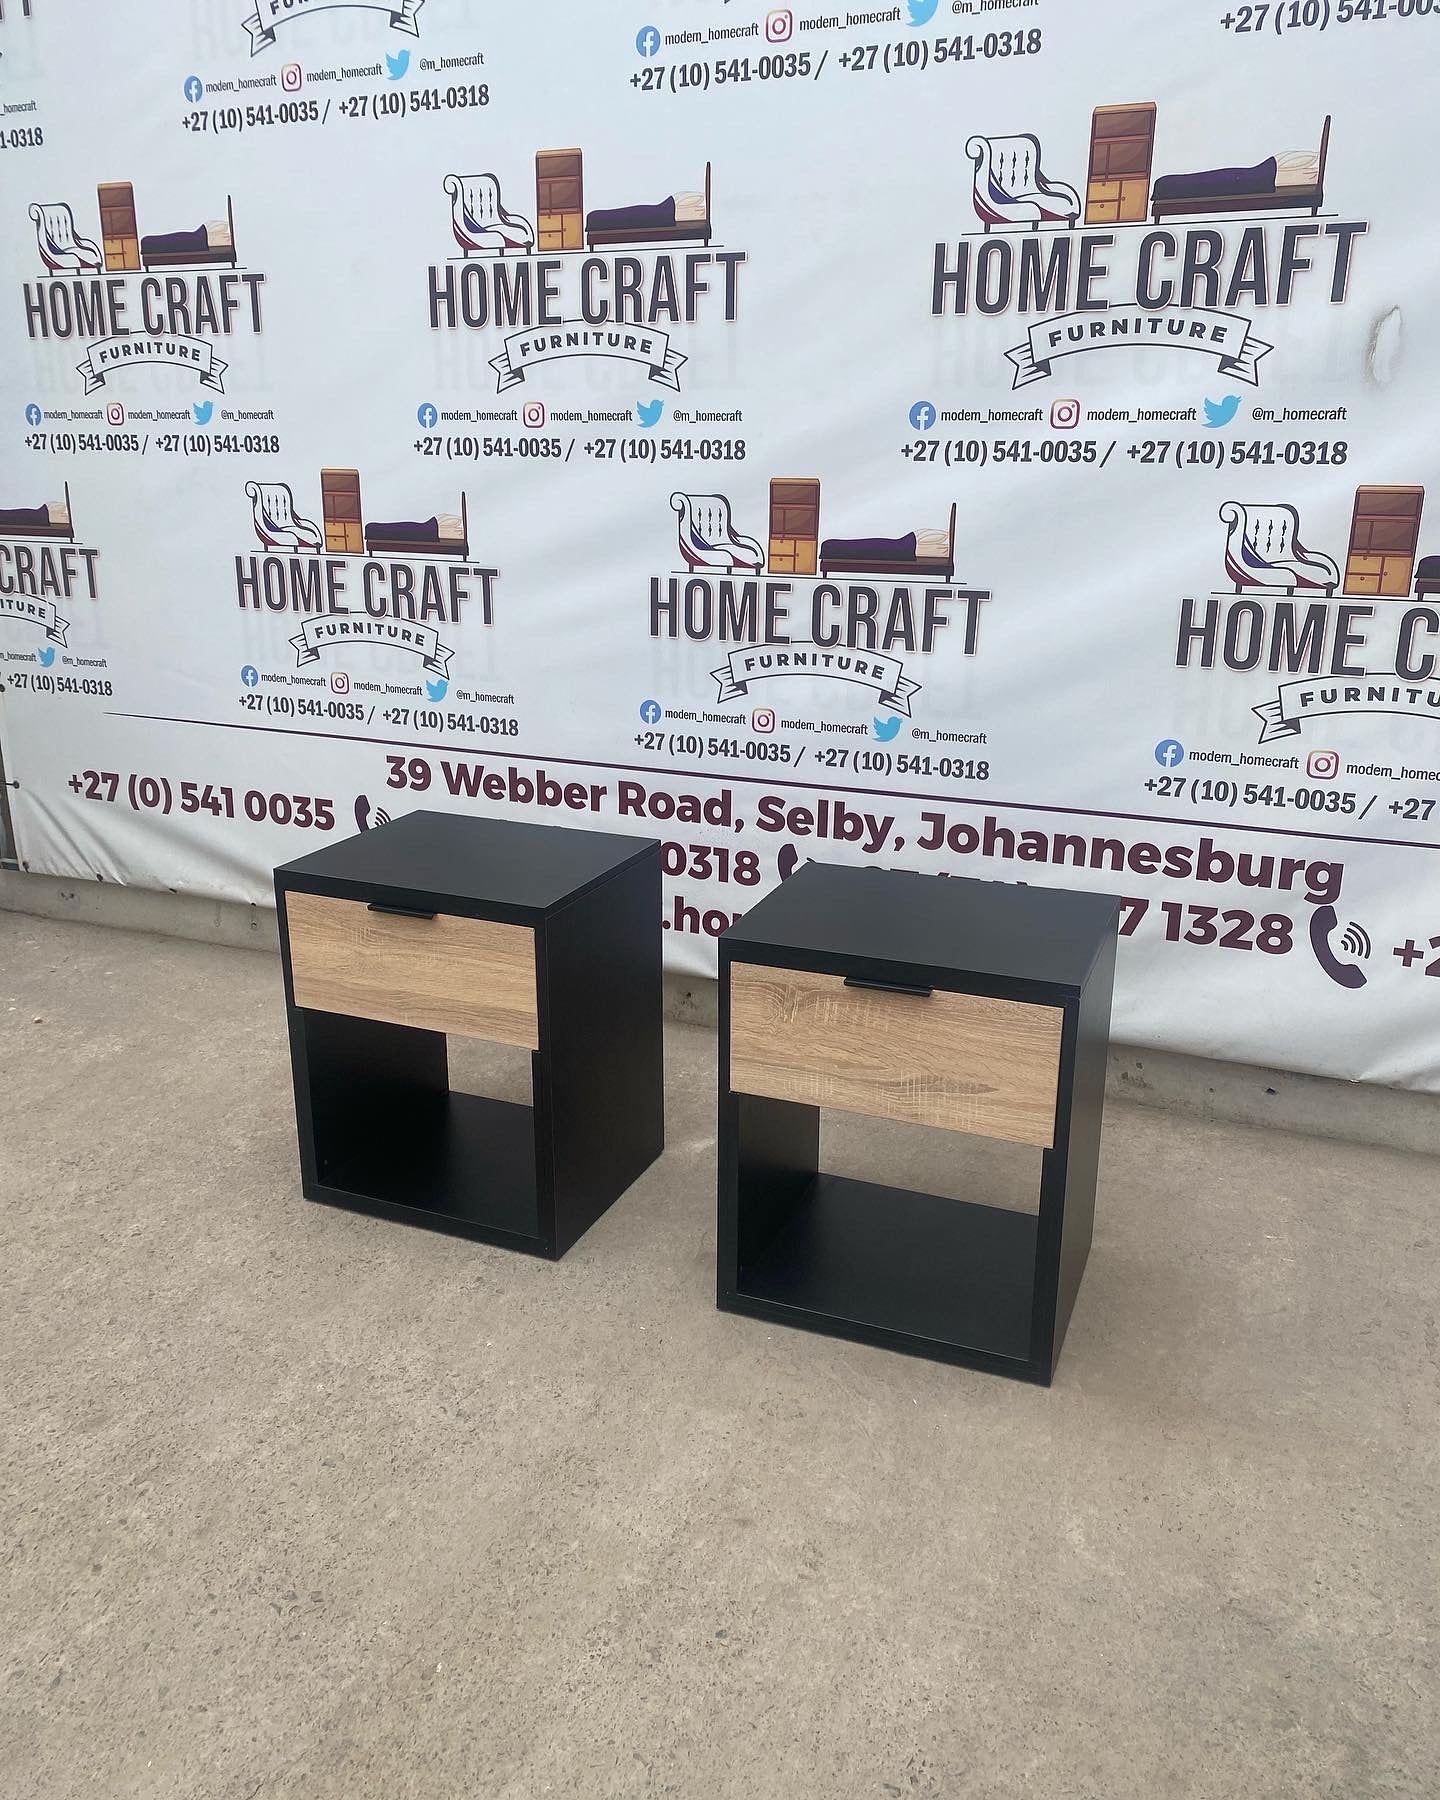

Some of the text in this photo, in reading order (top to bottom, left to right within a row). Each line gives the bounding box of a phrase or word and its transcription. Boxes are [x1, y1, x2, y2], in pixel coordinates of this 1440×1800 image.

[1220, 4, 1270, 33] +27
[1275, 0, 1331, 35] (10)
[630, 66, 665, 92] +27
[670, 62, 710, 94] (10)
[714, 52, 811, 86] 541-0035
[839, 45, 879, 72] +27
[884, 39, 928, 73] (10)
[933, 28, 1042, 64] 541-0318
[182, 111, 208, 132] +27
[212, 107, 242, 134] (10)
[246, 100, 319, 127] 541-0035
[339, 96, 368, 118] +27
[372, 91, 406, 120] (10)
[410, 84, 490, 112] 541-0318
[428, 251, 746, 329] HOME CRAFT
[932, 222, 1368, 315] HOME CRAFT
[23, 273, 265, 337] HOME CRAFT
[99, 341, 201, 364] FURNITURE
[519, 331, 653, 357] FURNITURE
[1049, 317, 1228, 347] FURNITURE
[673, 410, 743, 424] @m_homecraft
[1252, 407, 1347, 423] @m_homecraft
[24, 433, 47, 451] +27
[50, 433, 76, 454] (10)
[79, 434, 139, 452] 541-0035
[155, 435, 180, 452] +27
[183, 434, 211, 456] (10)
[214, 435, 280, 453] 541-0318
[413, 437, 442, 456] +27
[446, 437, 479, 460] (10)
[483, 437, 562, 458] 541-0035
[584, 438, 616, 459] +27
[620, 438, 656, 463] (10)
[660, 439, 746, 460] 541-0318
[900, 440, 939, 462] +27
[944, 439, 988, 467] (10)
[992, 440, 1097, 464] 541-0035
[1127, 441, 1171, 464] +27
[1176, 440, 1225, 468] (10)
[1230, 441, 1348, 465] 541-0318
[235, 556, 498, 625] HOME CRAFT
[314, 622, 425, 646] FURNITURE
[650, 577, 991, 655] HOME CRAFT
[1175, 599, 1374, 677] HOME
[8, 672, 113, 697] +27 (10) 541-0318
[744, 652, 885, 680] FURNITURE
[239, 694, 264, 711] +27
[267, 696, 295, 717] (10)
[298, 698, 364, 721] 541-0035
[383, 708, 409, 726] +27
[413, 710, 444, 732] (10)
[447, 713, 519, 737] 541-0318
[911, 728, 987, 745] @m_homecraft
[634, 733, 665, 752] +27
[669, 734, 704, 758] (10)
[708, 737, 791, 763] 541-0035
[814, 747, 848, 769] +27
[853, 750, 892, 776] (10)
[897, 754, 990, 780] 541-0318
[68, 770, 335, 831] +27 (0) 541 0035
[1144, 776, 1187, 798] +27
[1191, 779, 1238, 807] (10)
[1243, 783, 1356, 814] 541-0035
[1388, 798, 1436, 821] +27
[386, 756, 432, 792] 39
[443, 762, 607, 812] Webber
[617, 782, 744, 833] Road,
[755, 794, 905, 854] Selby,
[917, 812, 1345, 905] Johannesburg
[660, 841, 761, 886] 0318
[1161, 901, 1294, 955] 1328
